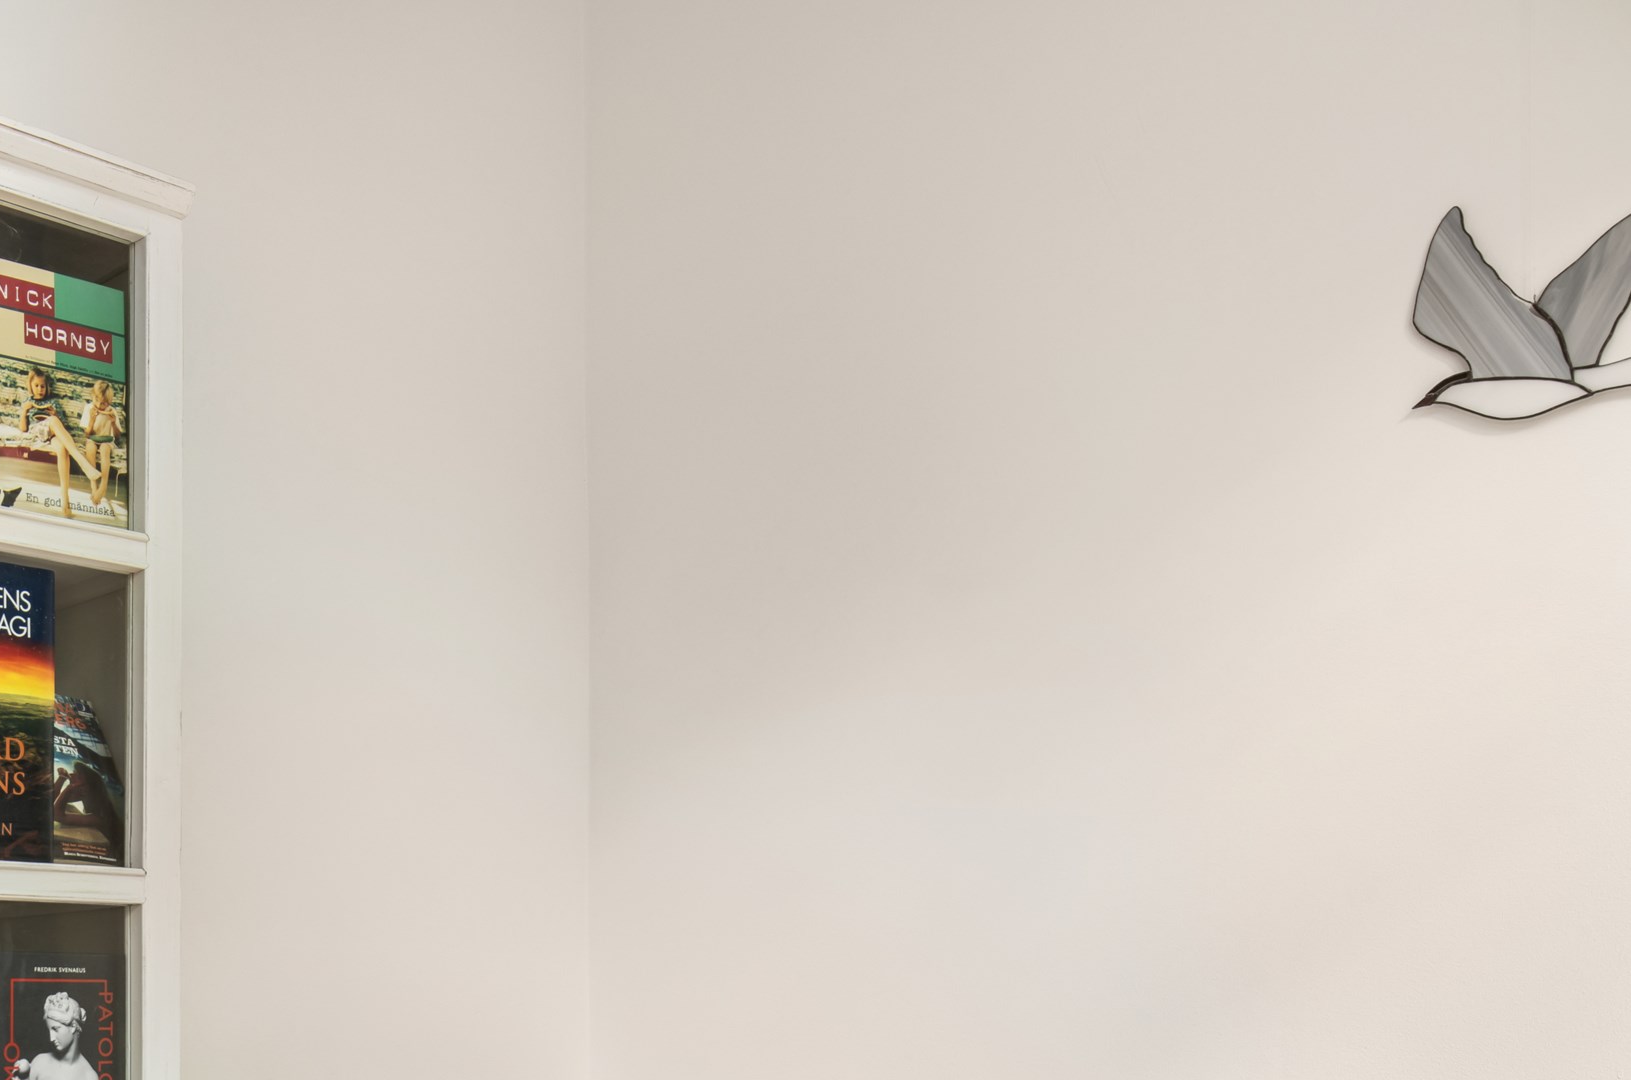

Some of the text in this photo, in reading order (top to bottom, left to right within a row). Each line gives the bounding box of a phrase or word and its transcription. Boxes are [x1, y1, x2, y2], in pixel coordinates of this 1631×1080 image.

[25, 321, 110, 355] HORNBY
[26, 492, 116, 517] En god människa
[58, 966, 86, 974] SVENAEUS
